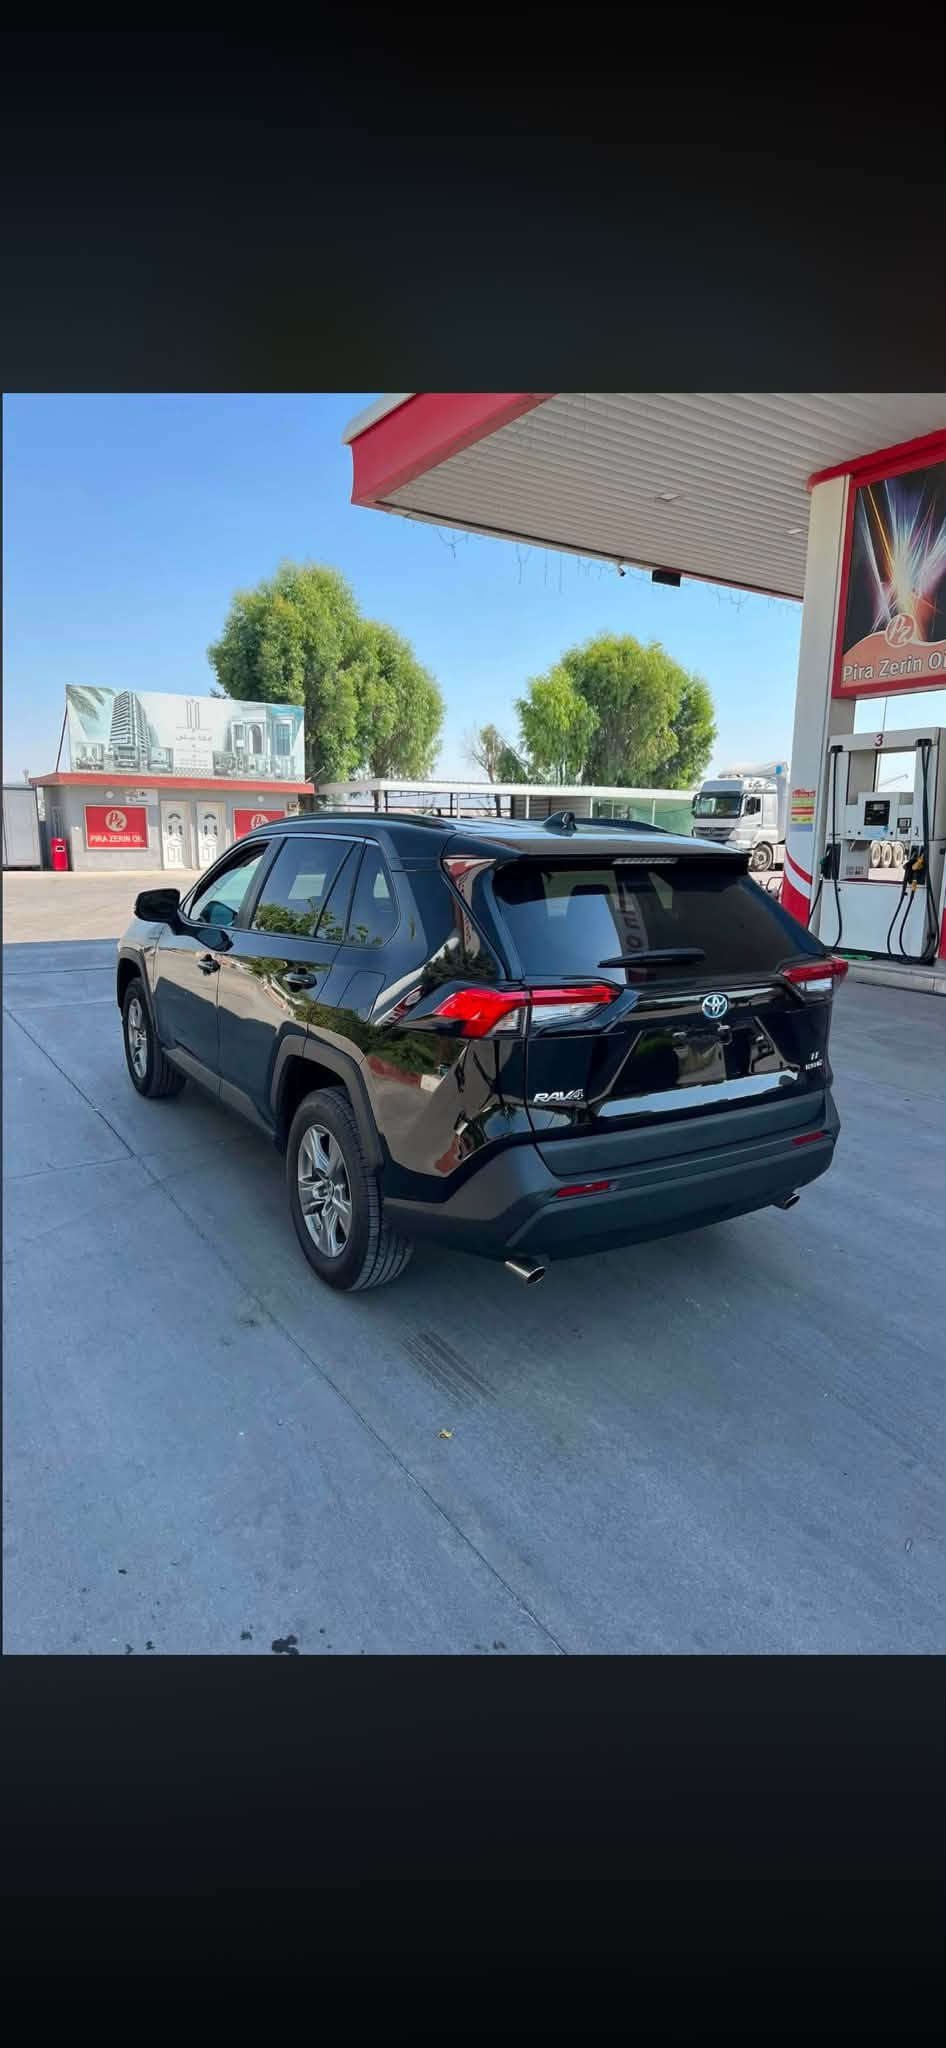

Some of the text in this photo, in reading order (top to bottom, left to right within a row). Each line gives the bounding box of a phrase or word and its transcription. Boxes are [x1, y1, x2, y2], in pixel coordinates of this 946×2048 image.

[842, 663, 874, 682] Pira
[878, 656, 923, 678] Zerin
[874, 733, 884, 747] 3
[90, 834, 108, 843] PIRA
[110, 834, 131, 843] ZERIN
[533, 1088, 584, 1103] RAV4
